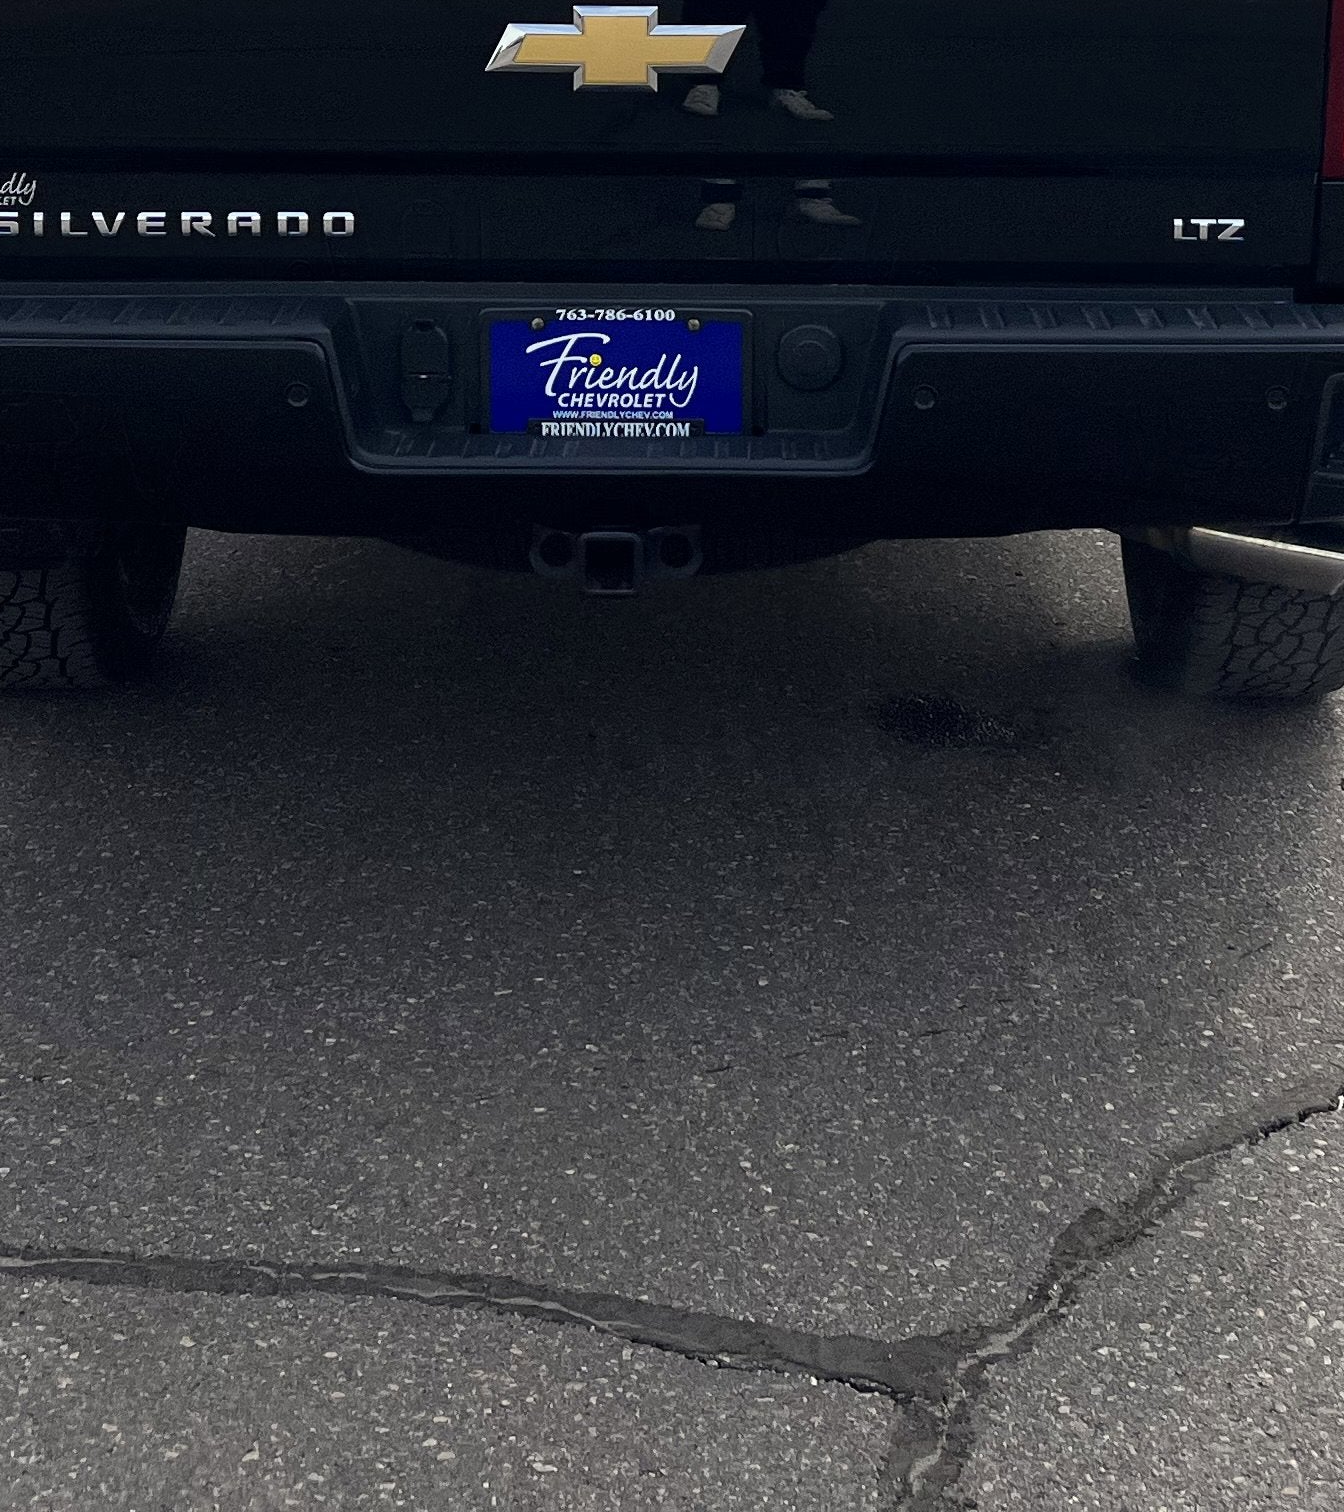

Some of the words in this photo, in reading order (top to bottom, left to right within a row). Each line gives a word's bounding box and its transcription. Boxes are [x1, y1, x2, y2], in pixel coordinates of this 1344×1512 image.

[1173, 218, 1245, 241] LTZ
[555, 308, 676, 322] 763-786-6100
[525, 332, 699, 408] Friendly
[558, 392, 666, 408] CHEVROLET
[552, 410, 674, 420] WWW.FRIENDLYCHEV.COM
[541, 422, 691, 438] FRIENDLYCHEV.COM
